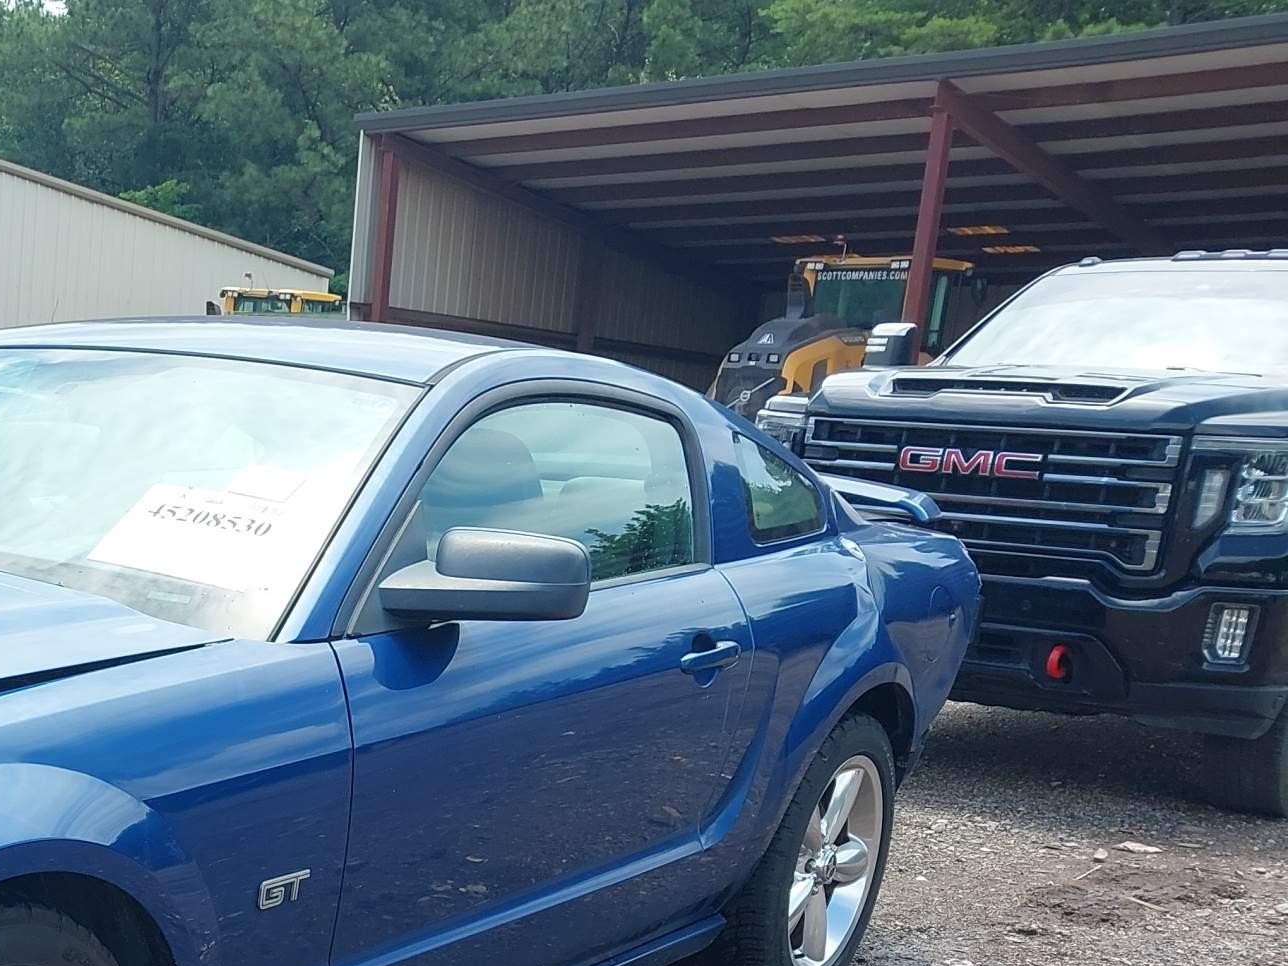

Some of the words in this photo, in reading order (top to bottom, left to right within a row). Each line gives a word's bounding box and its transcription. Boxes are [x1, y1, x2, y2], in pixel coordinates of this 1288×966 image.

[817, 270, 908, 281] SCOTTCOMPANIES.COM
[899, 445, 1043, 480] GMC
[148, 503, 273, 537] 45208530
[259, 868, 311, 911] GT
